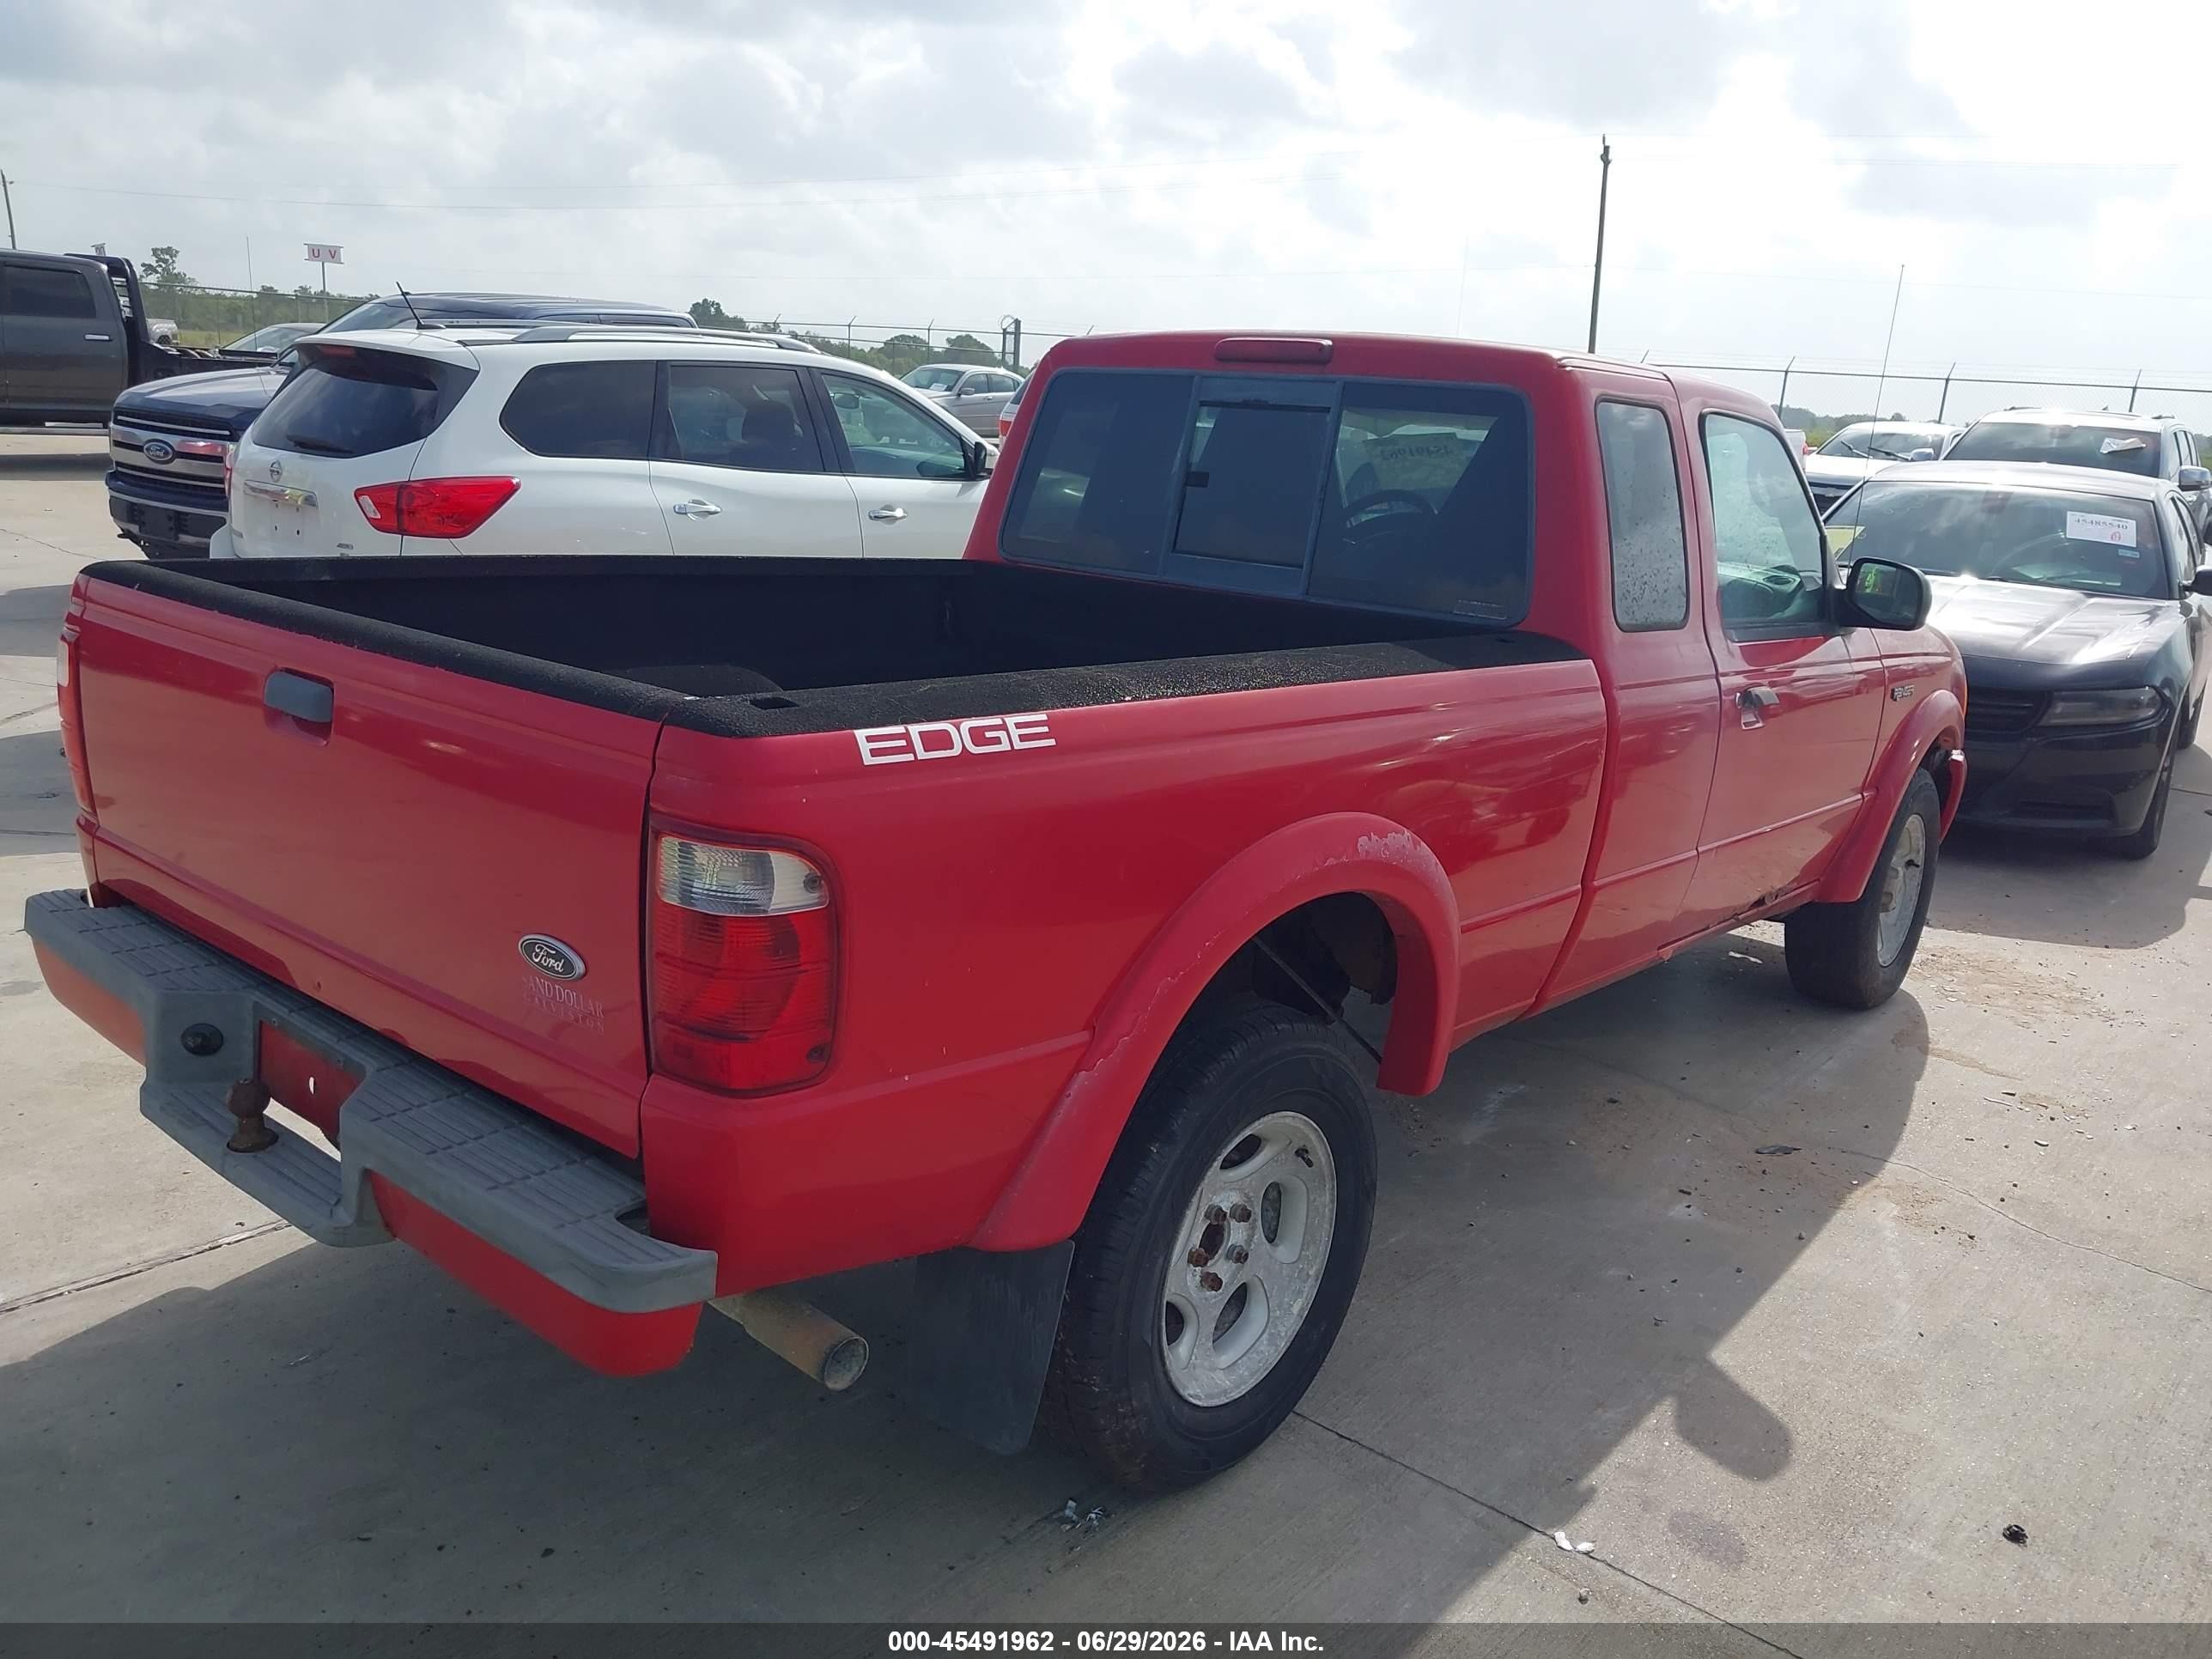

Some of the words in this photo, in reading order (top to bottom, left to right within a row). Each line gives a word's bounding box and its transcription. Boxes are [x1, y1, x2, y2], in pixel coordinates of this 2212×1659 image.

[854, 714, 1057, 766] EDGE
[532, 944, 565, 973] Ford
[555, 984, 604, 1018] DOLLAR
